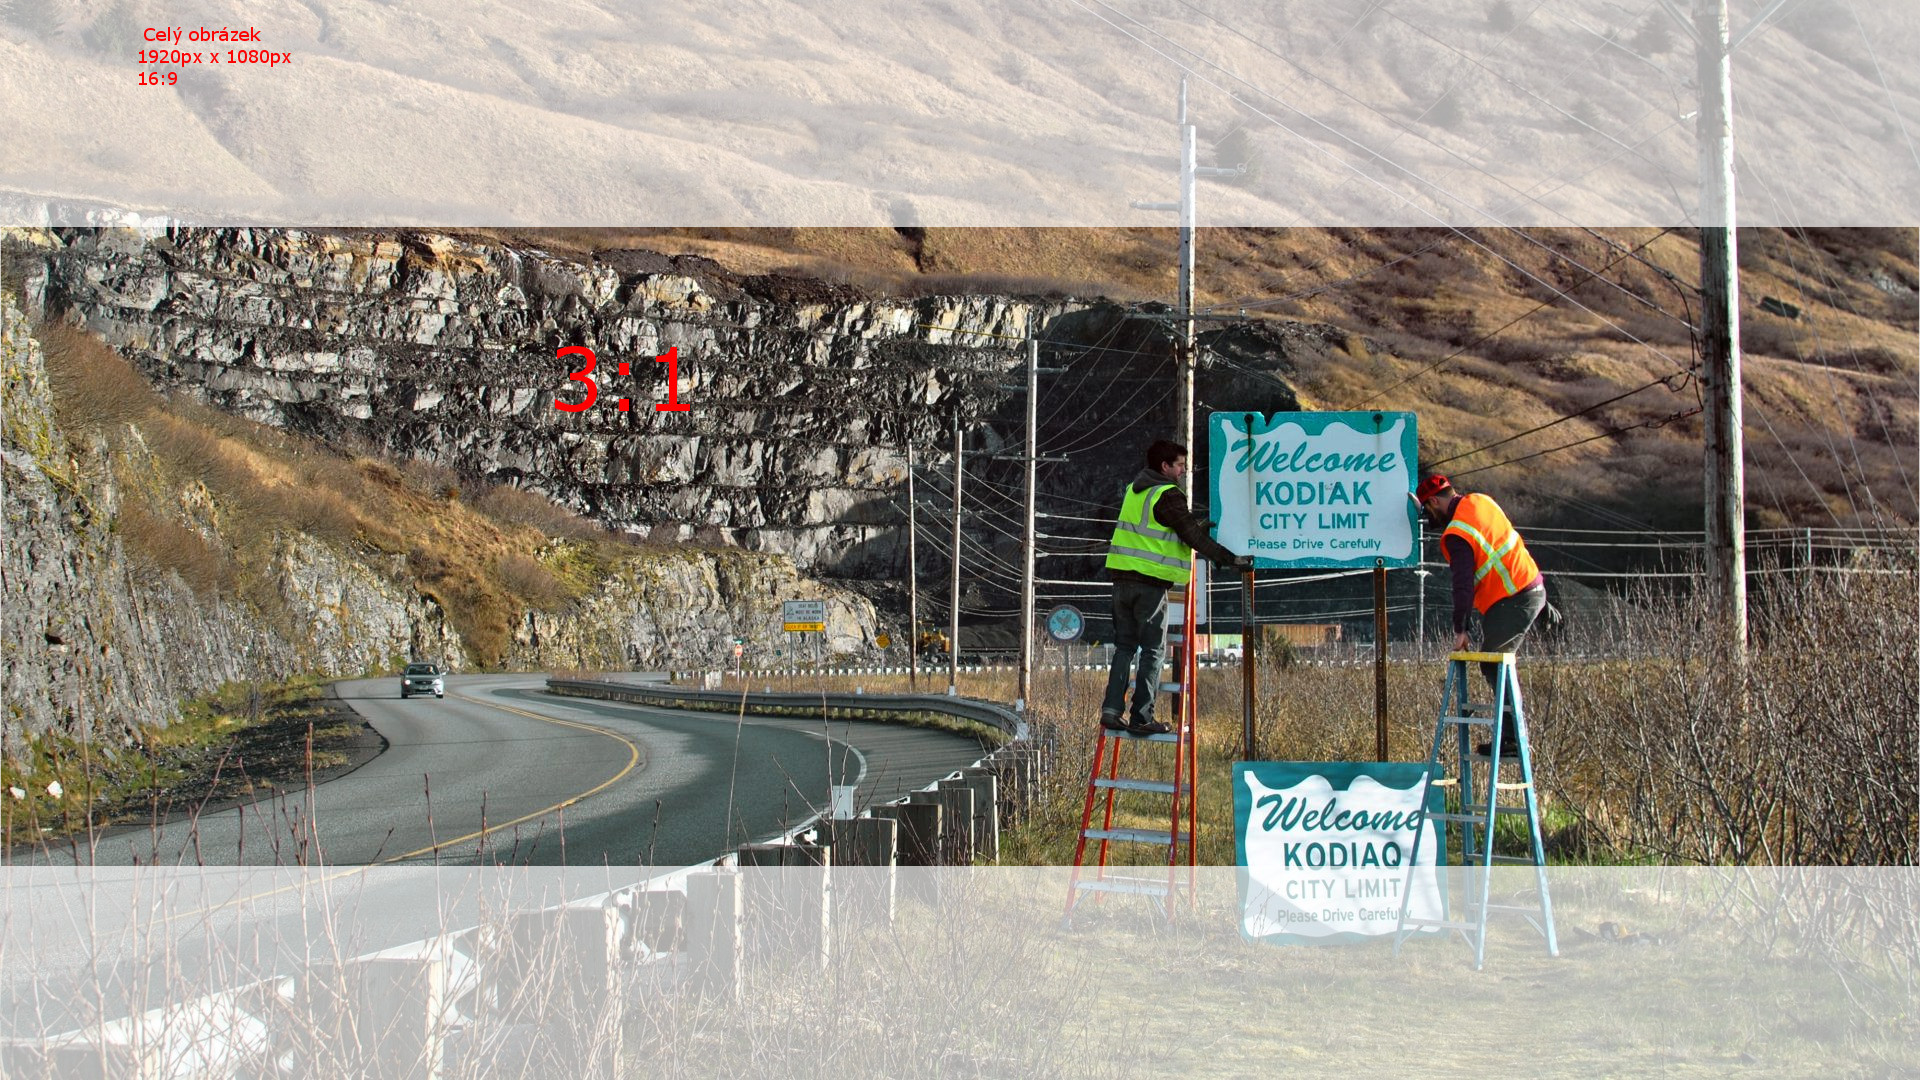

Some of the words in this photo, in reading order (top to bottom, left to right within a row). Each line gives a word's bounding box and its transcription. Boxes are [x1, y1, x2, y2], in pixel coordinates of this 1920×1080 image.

[1231, 438, 1396, 473] Welcome
[1256, 481, 1372, 505] KODIAK
[1260, 513, 1307, 530] CITY
[1319, 513, 1369, 529] LIMIT
[1248, 539, 1287, 549] Please
[1293, 539, 1324, 549] Drive
[1330, 538, 1381, 551] Carefully
[1256, 794, 1422, 832] Welcome
[1284, 842, 1402, 871] KODIAQ
[1286, 879, 1335, 900] CITY
[1345, 878, 1401, 898] LIMIT
[1277, 909, 1318, 923] Please
[1322, 908, 1355, 922] Drive
